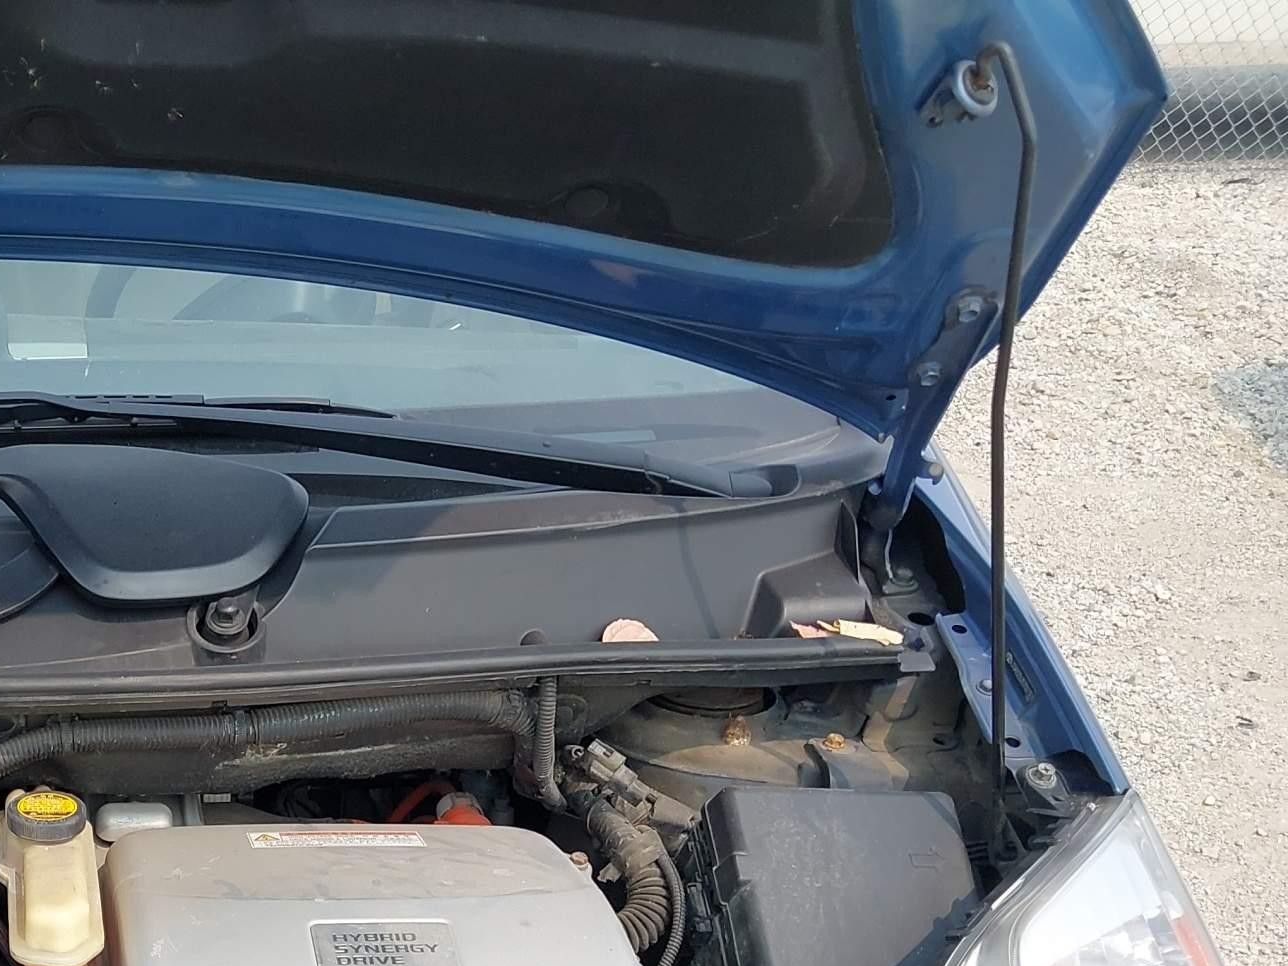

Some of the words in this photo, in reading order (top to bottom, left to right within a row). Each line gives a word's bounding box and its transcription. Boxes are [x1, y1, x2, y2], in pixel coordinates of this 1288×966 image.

[331, 932, 417, 942] HYBRID
[333, 943, 440, 954] SYNERGY
[335, 955, 407, 966] DRIVE
